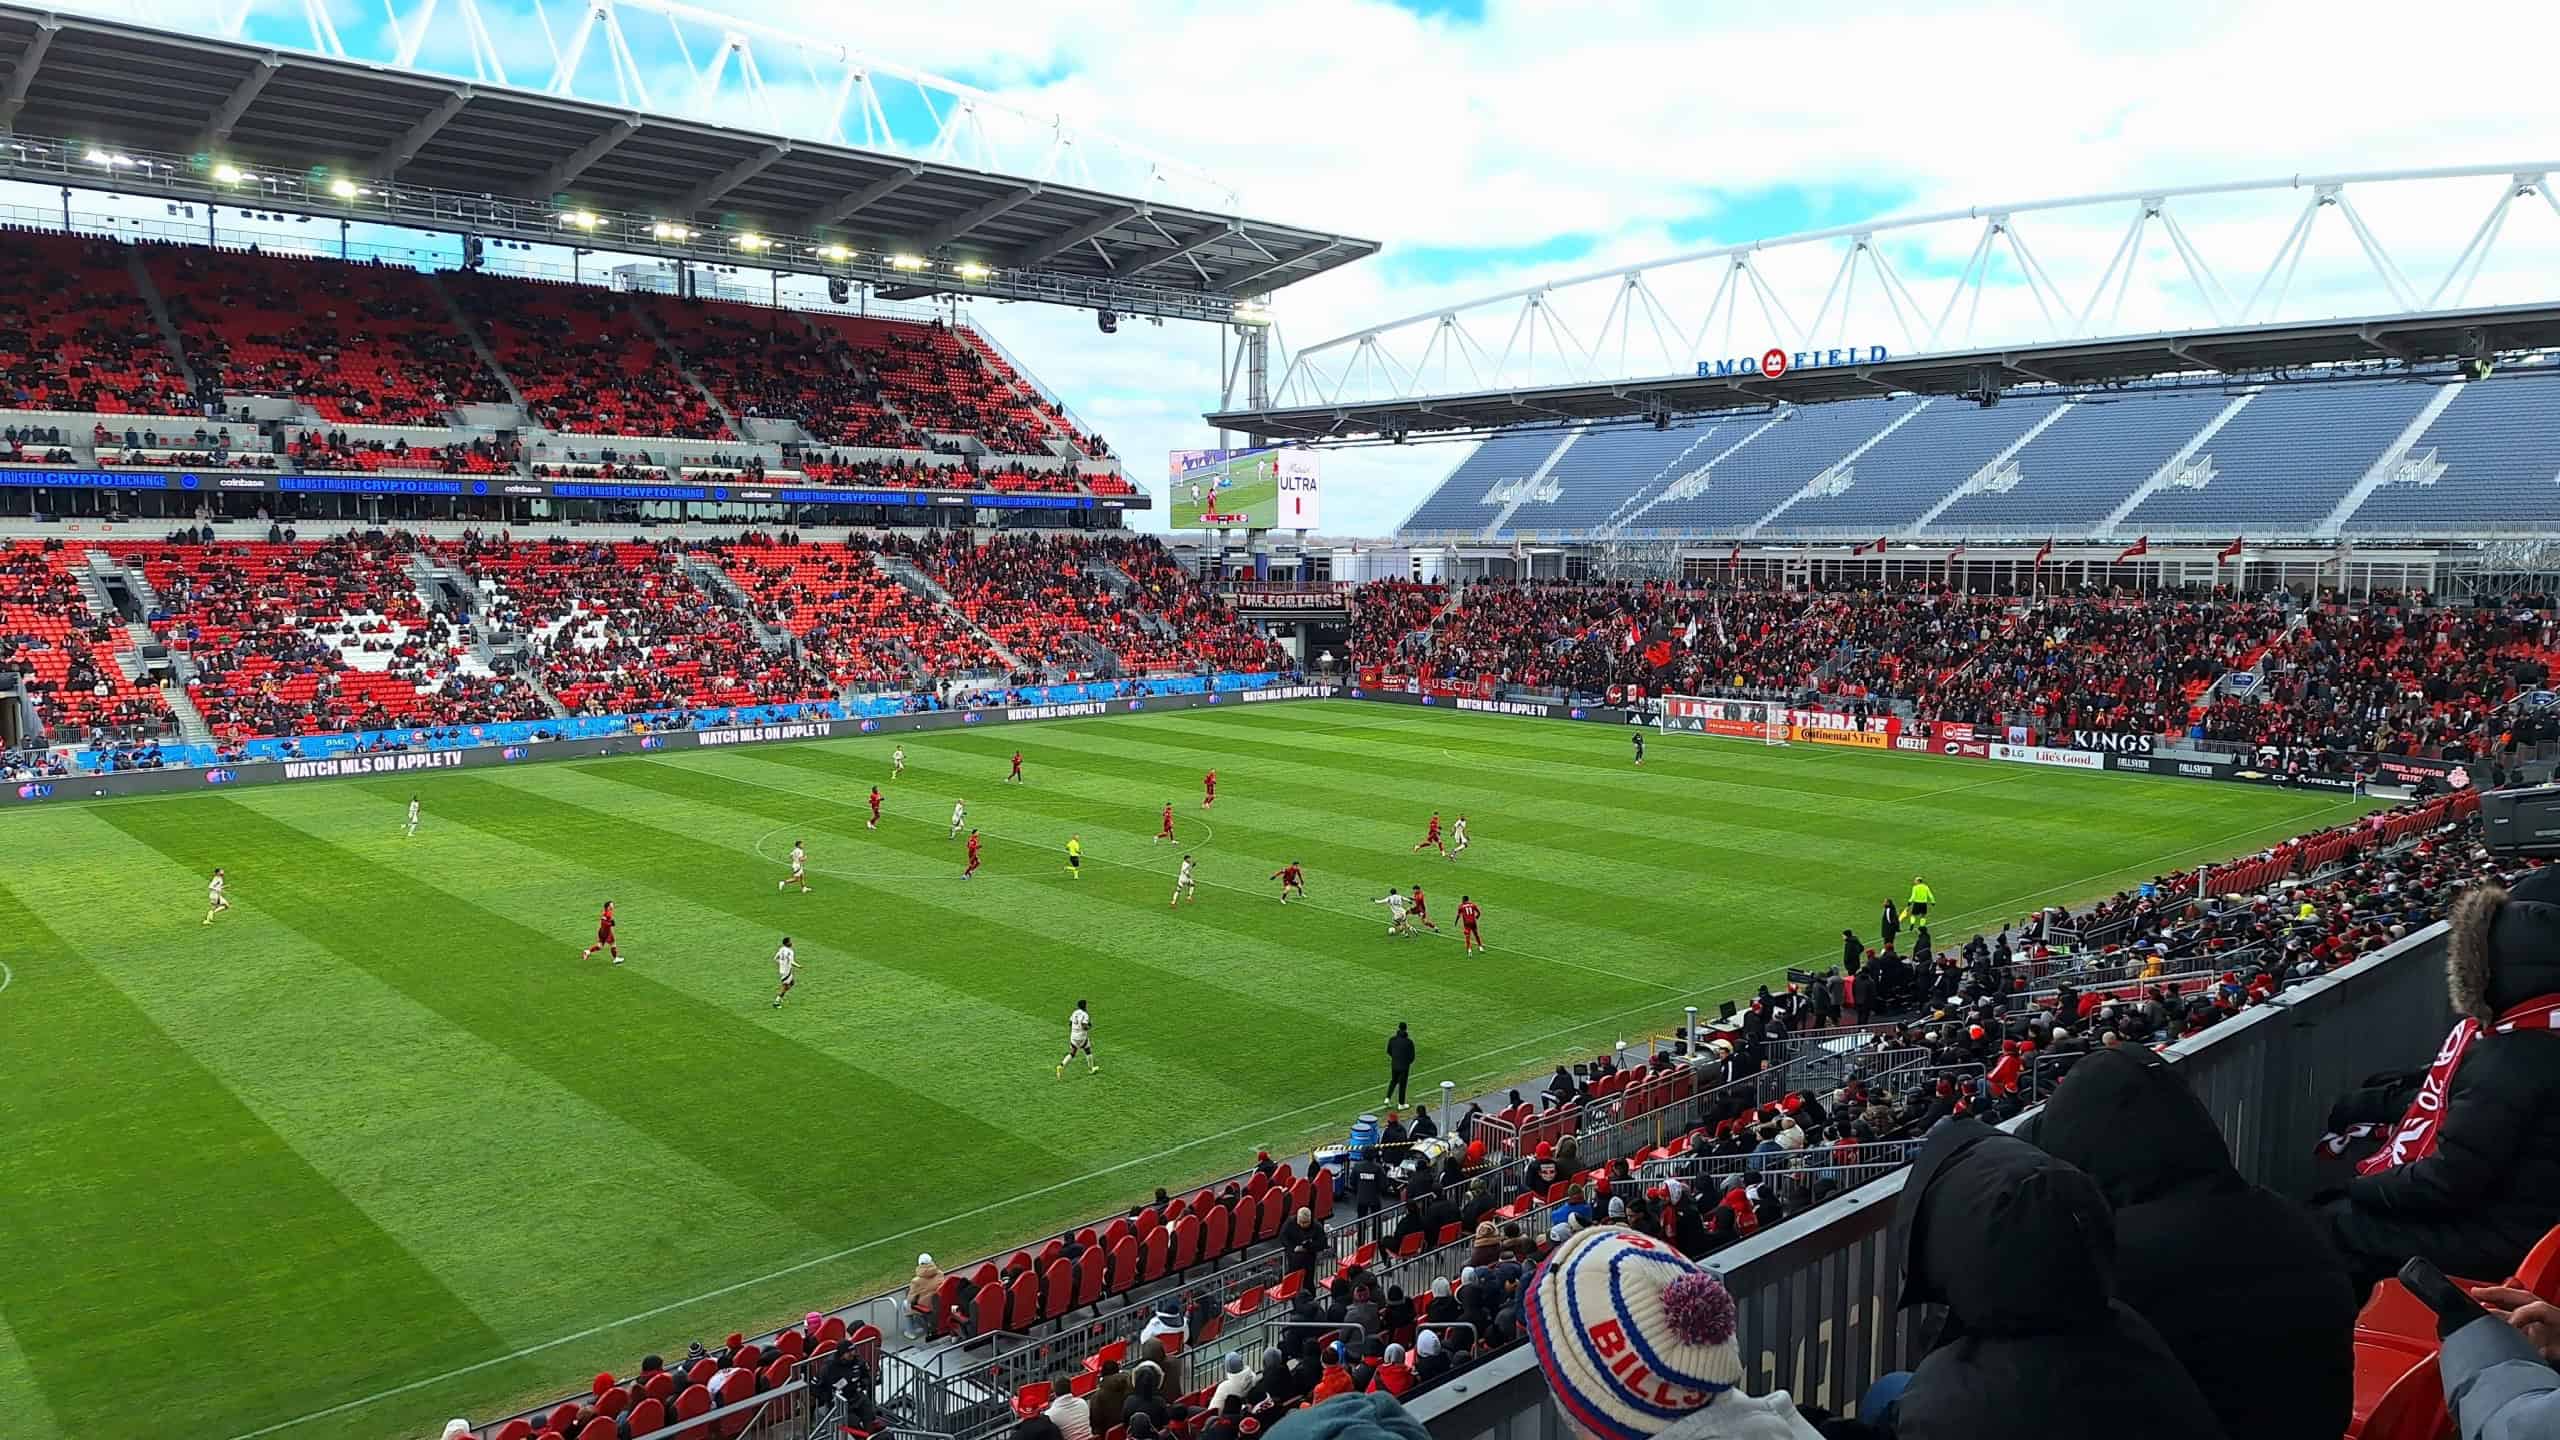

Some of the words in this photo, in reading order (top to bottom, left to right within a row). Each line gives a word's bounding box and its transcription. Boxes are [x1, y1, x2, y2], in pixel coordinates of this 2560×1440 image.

[1696, 356, 1756, 377] BMO
[1792, 345, 1887, 369] FIELD
[46, 473, 112, 485] CRYPTO
[114, 474, 166, 487] EXCHANGE
[279, 479, 298, 489] THE
[299, 479, 322, 490] MOST
[324, 480, 361, 491] TRUSTED
[363, 481, 416, 492] CRYPTO
[418, 482, 461, 493] EXCHANGE
[1280, 477, 1317, 491] ULTRA
[623, 488, 668, 497] CRYPTO
[1240, 594, 1265, 606] THE
[1268, 594, 1342, 606] FORTRESS
[1292, 687, 1318, 698] APPLE
[1320, 686, 1331, 696] TV
[1007, 708, 1038, 721] WATCH
[1039, 707, 1056, 719] MLS
[1069, 704, 1093, 716] APPLE
[1094, 703, 1106, 714] TV
[1511, 703, 1536, 715] APPLE
[1537, 706, 1548, 717] TV
[1793, 711, 1888, 733] TERRACE
[699, 730, 738, 746] WATCH
[739, 729, 763, 743] MLS
[765, 727, 781, 741] ON
[782, 725, 814, 739] APPLE
[815, 723, 830, 736] TV
[1859, 733, 1881, 745] Tire
[2074, 730, 2151, 753] KINGS
[515, 747, 528, 758] tv
[2011, 749, 2024, 758] LG
[2036, 751, 2062, 763] Life's
[2063, 752, 2094, 766] Good.
[284, 760, 338, 779] WATCH
[341, 758, 371, 775] MLS
[374, 756, 394, 772] ON
[397, 753, 442, 770] APPLE
[443, 751, 462, 766] TV
[221, 769, 236, 782] tv
[34, 784, 51, 798] tv
[1465, 906, 1473, 916] 11
